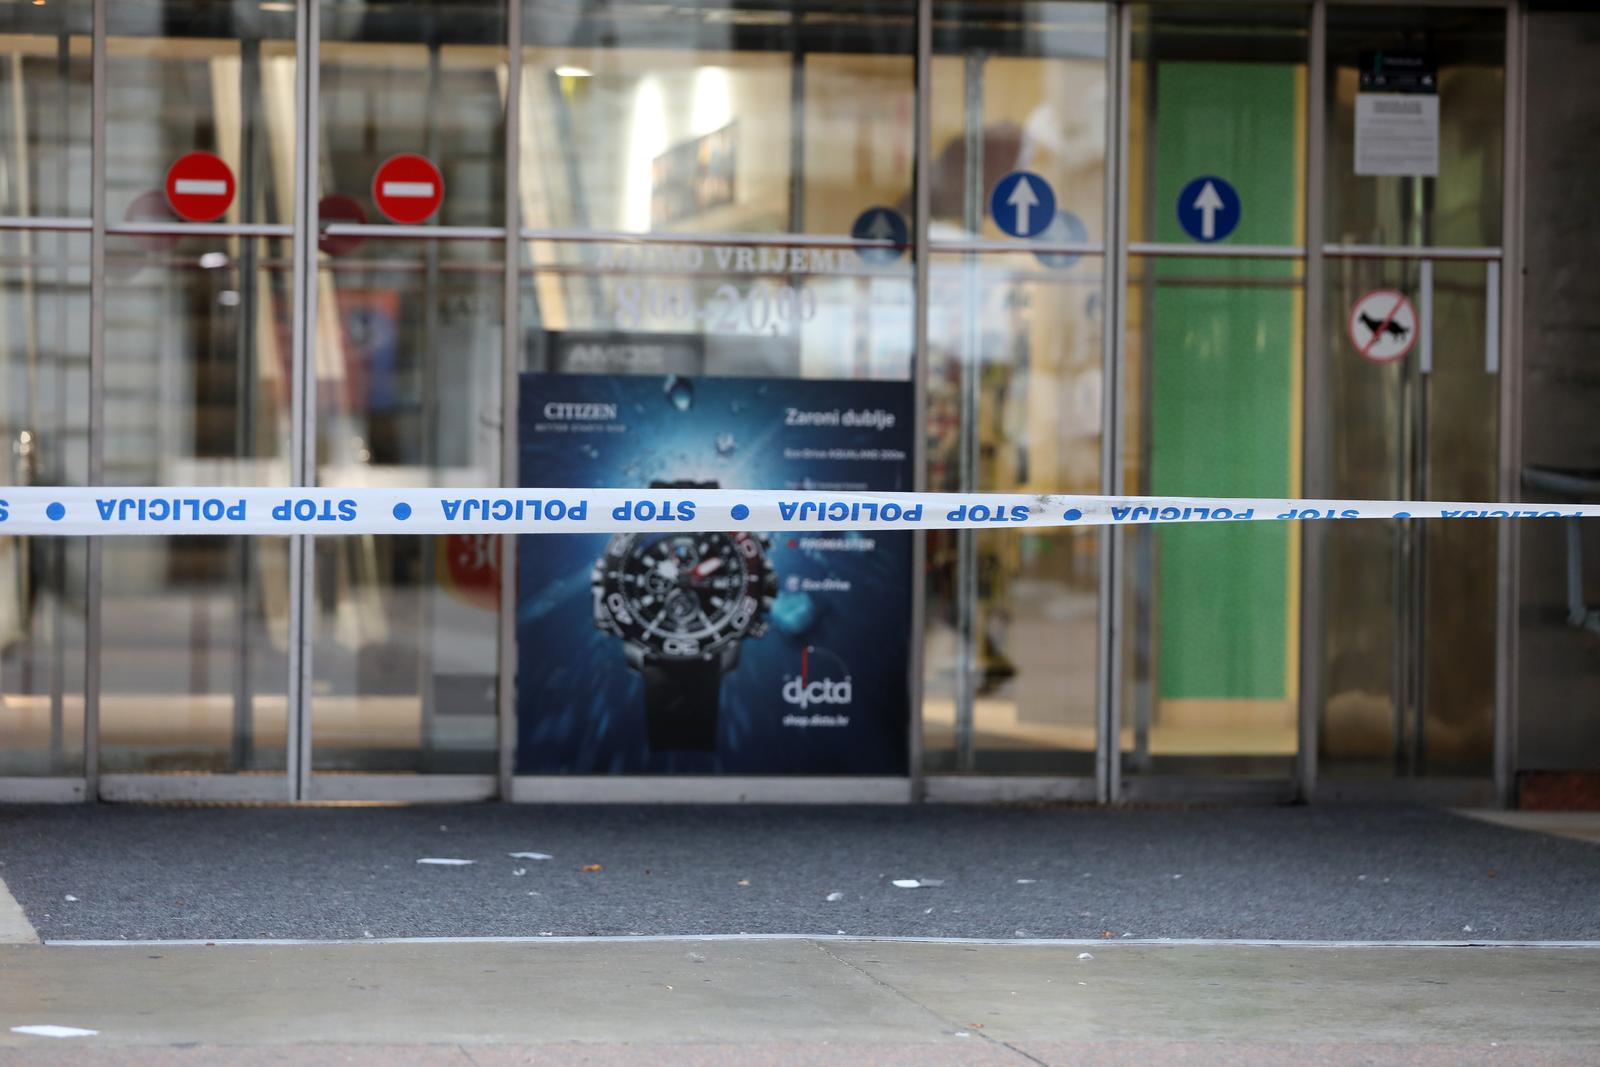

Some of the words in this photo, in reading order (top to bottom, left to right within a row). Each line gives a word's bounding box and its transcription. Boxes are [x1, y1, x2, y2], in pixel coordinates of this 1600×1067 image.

[543, 402, 617, 421] CITIZEN
[785, 407, 840, 427] Zaroni
[841, 408, 897, 431] dublje
[95, 497, 248, 523] POLICIJA
[271, 498, 358, 522] STOP
[439, 497, 589, 523] POLICIJA
[611, 499, 697, 523] STOP
[777, 500, 925, 522] POLICIJA
[945, 503, 1030, 523] STOP
[1110, 505, 1255, 522] POLICIJA
